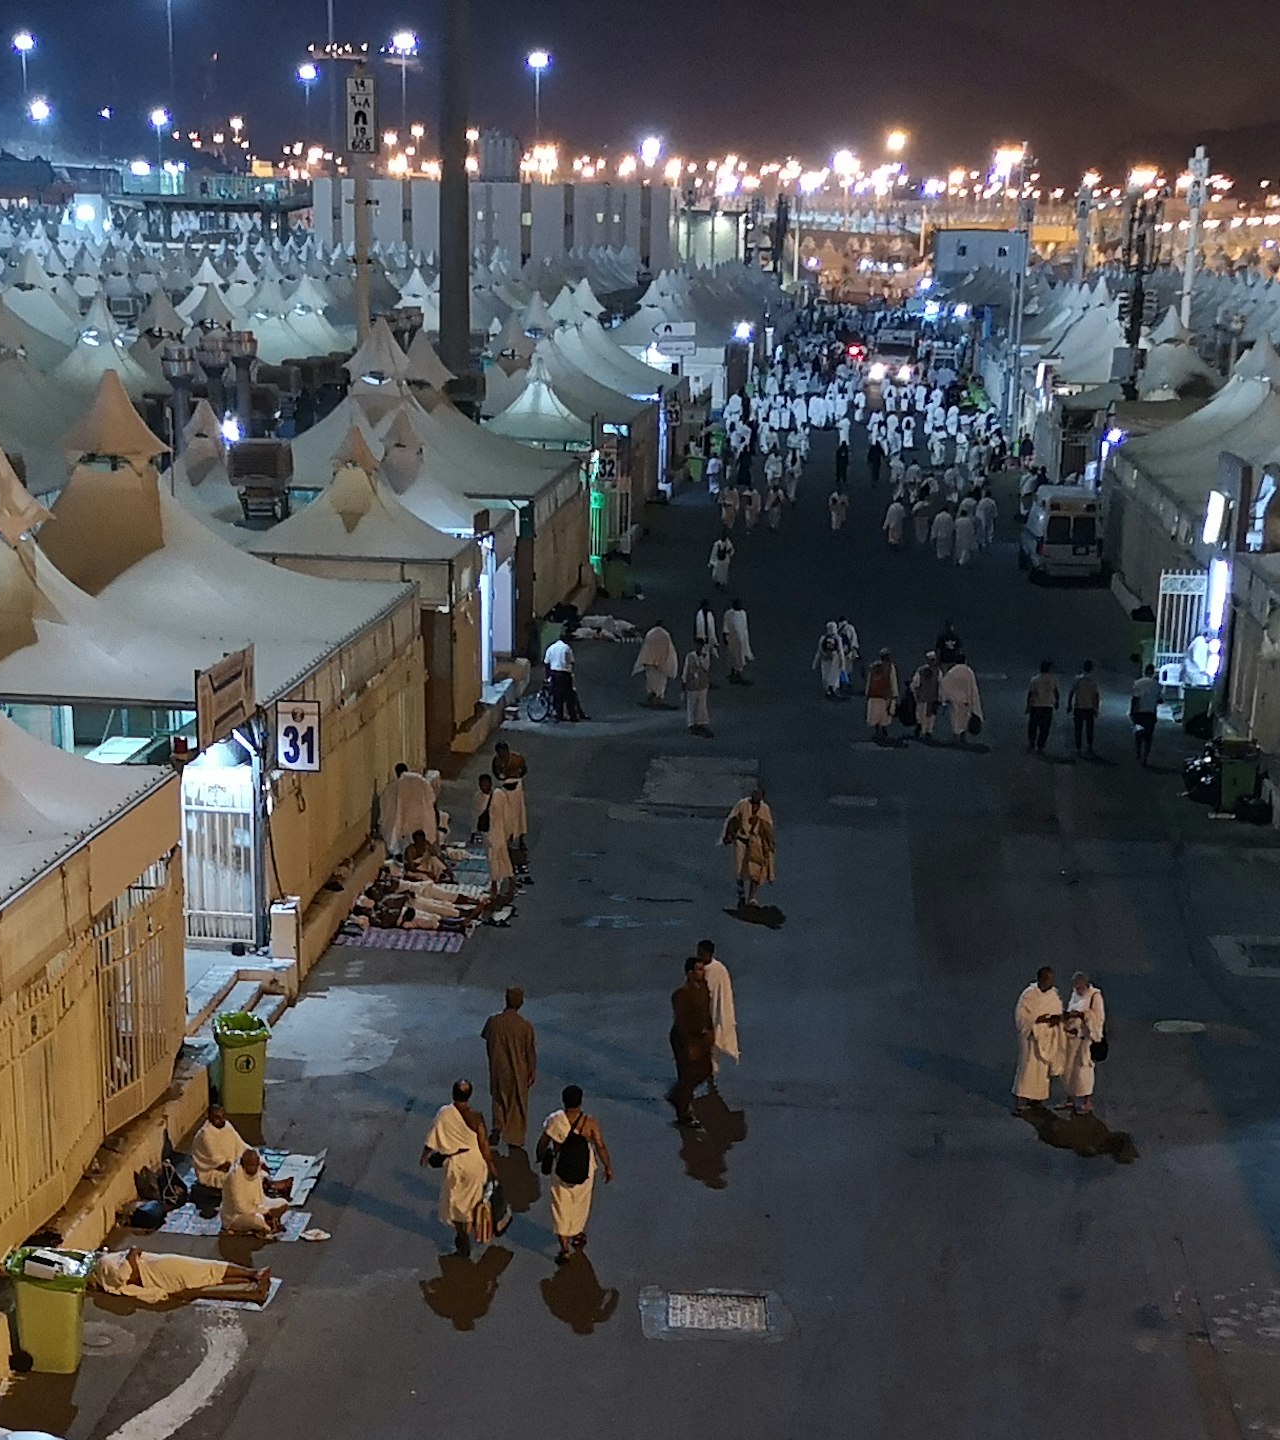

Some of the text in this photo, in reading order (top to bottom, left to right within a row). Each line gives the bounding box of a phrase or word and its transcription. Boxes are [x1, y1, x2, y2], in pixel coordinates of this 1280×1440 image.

[354, 80, 366, 92] ١٩
[351, 95, 370, 108] ٦٠٨
[355, 127, 367, 138] 19
[351, 139, 371, 151] 608
[598, 458, 615, 478] 32
[283, 725, 315, 764] 31
